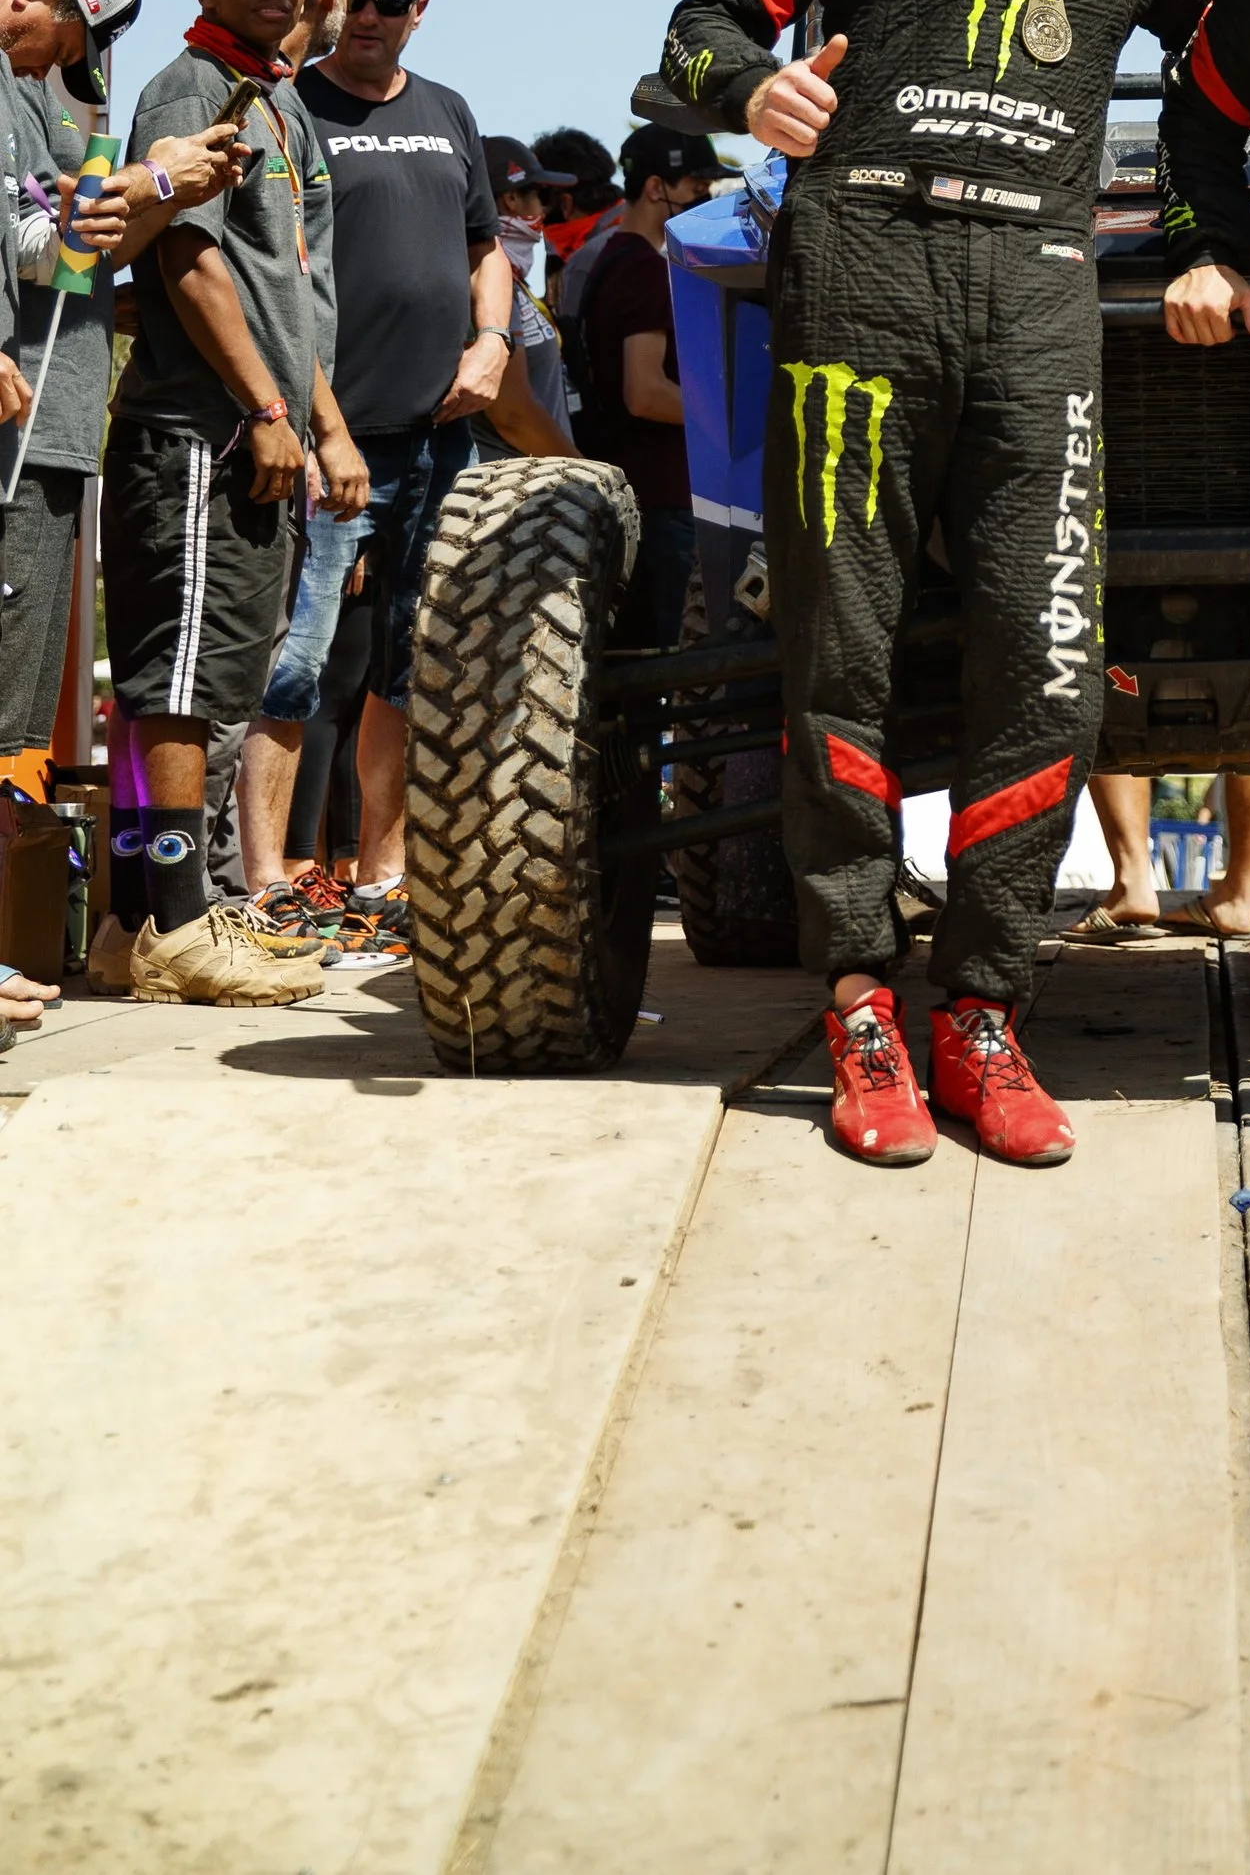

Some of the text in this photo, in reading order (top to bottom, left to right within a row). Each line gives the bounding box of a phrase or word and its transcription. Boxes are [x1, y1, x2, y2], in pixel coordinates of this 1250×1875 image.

[926, 87, 1076, 135] MAGPUL
[327, 135, 454, 156] POLARIS
[910, 118, 1055, 152] NITTO
[848, 168, 906, 187] sparco
[964, 184, 1042, 212] S. BERRIMAN
[1039, 390, 1094, 700] MONSTER
